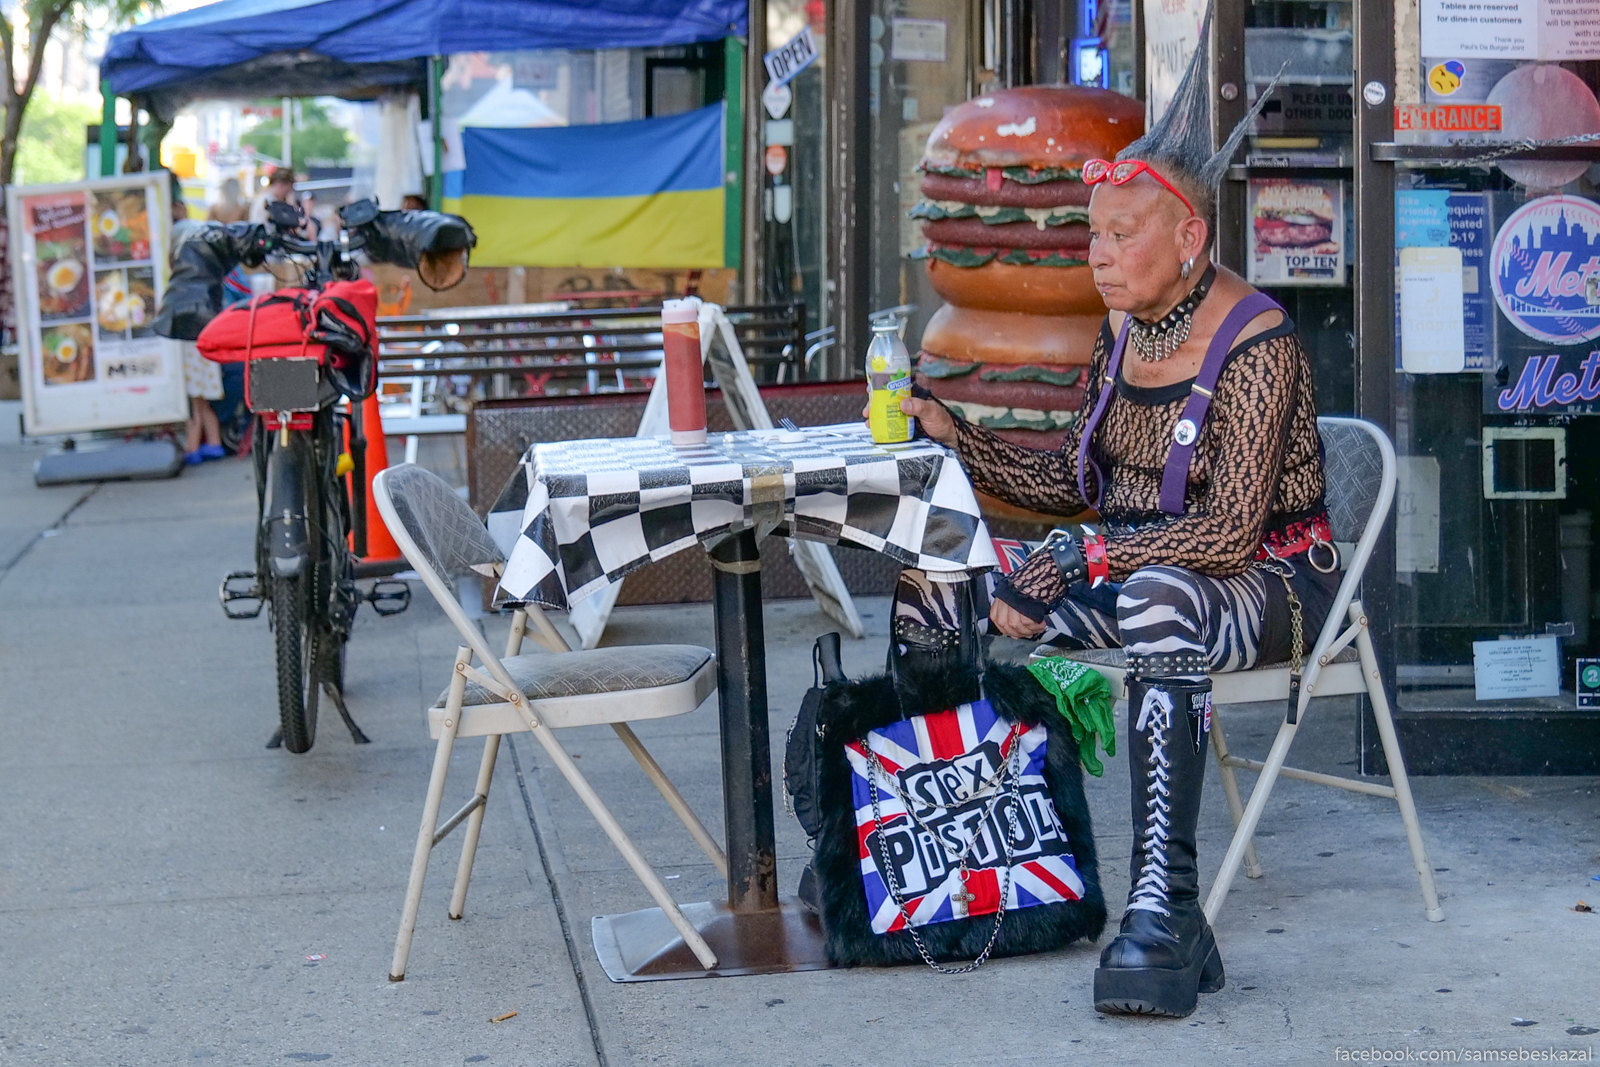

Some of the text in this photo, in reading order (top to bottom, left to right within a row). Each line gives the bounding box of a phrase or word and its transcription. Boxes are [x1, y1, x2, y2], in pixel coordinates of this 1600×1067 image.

[1440, 2, 1466, 11] Tables
[1484, 3, 1518, 11] reserved
[1437, 15, 1522, 24] for dine-in customers
[1490, 44, 1509, 52] Burger
[1510, 44, 1525, 52] Joint
[772, 34, 813, 79] OPEN
[1292, 93, 1334, 105] PLEASE
[1285, 108, 1321, 119] OTHER
[1398, 106, 1498, 129] ENTRANCE
[1399, 206, 1438, 216] Friendly
[1285, 256, 1338, 268] TOP TEN
